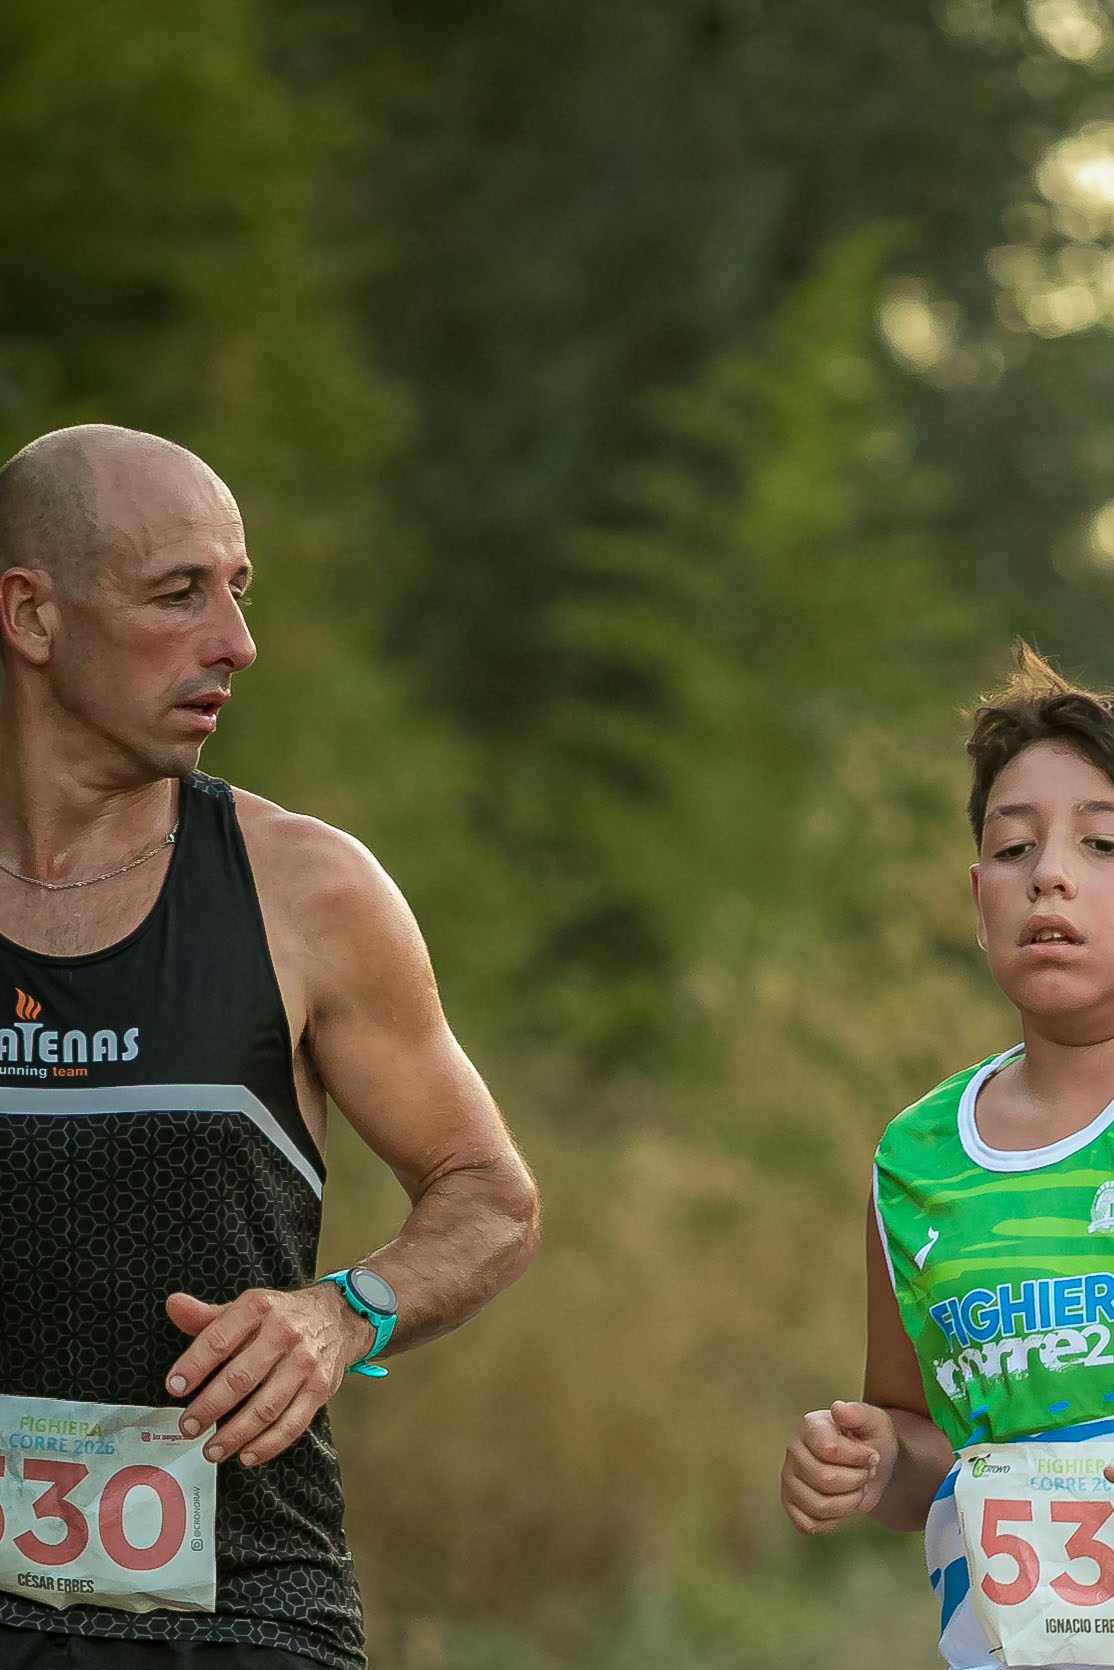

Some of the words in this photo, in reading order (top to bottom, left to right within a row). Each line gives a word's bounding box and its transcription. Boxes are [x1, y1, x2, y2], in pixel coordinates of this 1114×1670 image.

[0, 1065, 48, 1079] unning
[53, 1066, 88, 1077] team
[19, 1416, 104, 1437] FIGHIERA
[9, 1433, 67, 1453] CORRE
[73, 1439, 115, 1456] 2026
[1030, 1476, 1087, 1492] CORRE
[0, 1456, 187, 1571] 30
[17, 1571, 54, 1590] CÉSAR
[1045, 1618, 1092, 1634] IGNACIO
